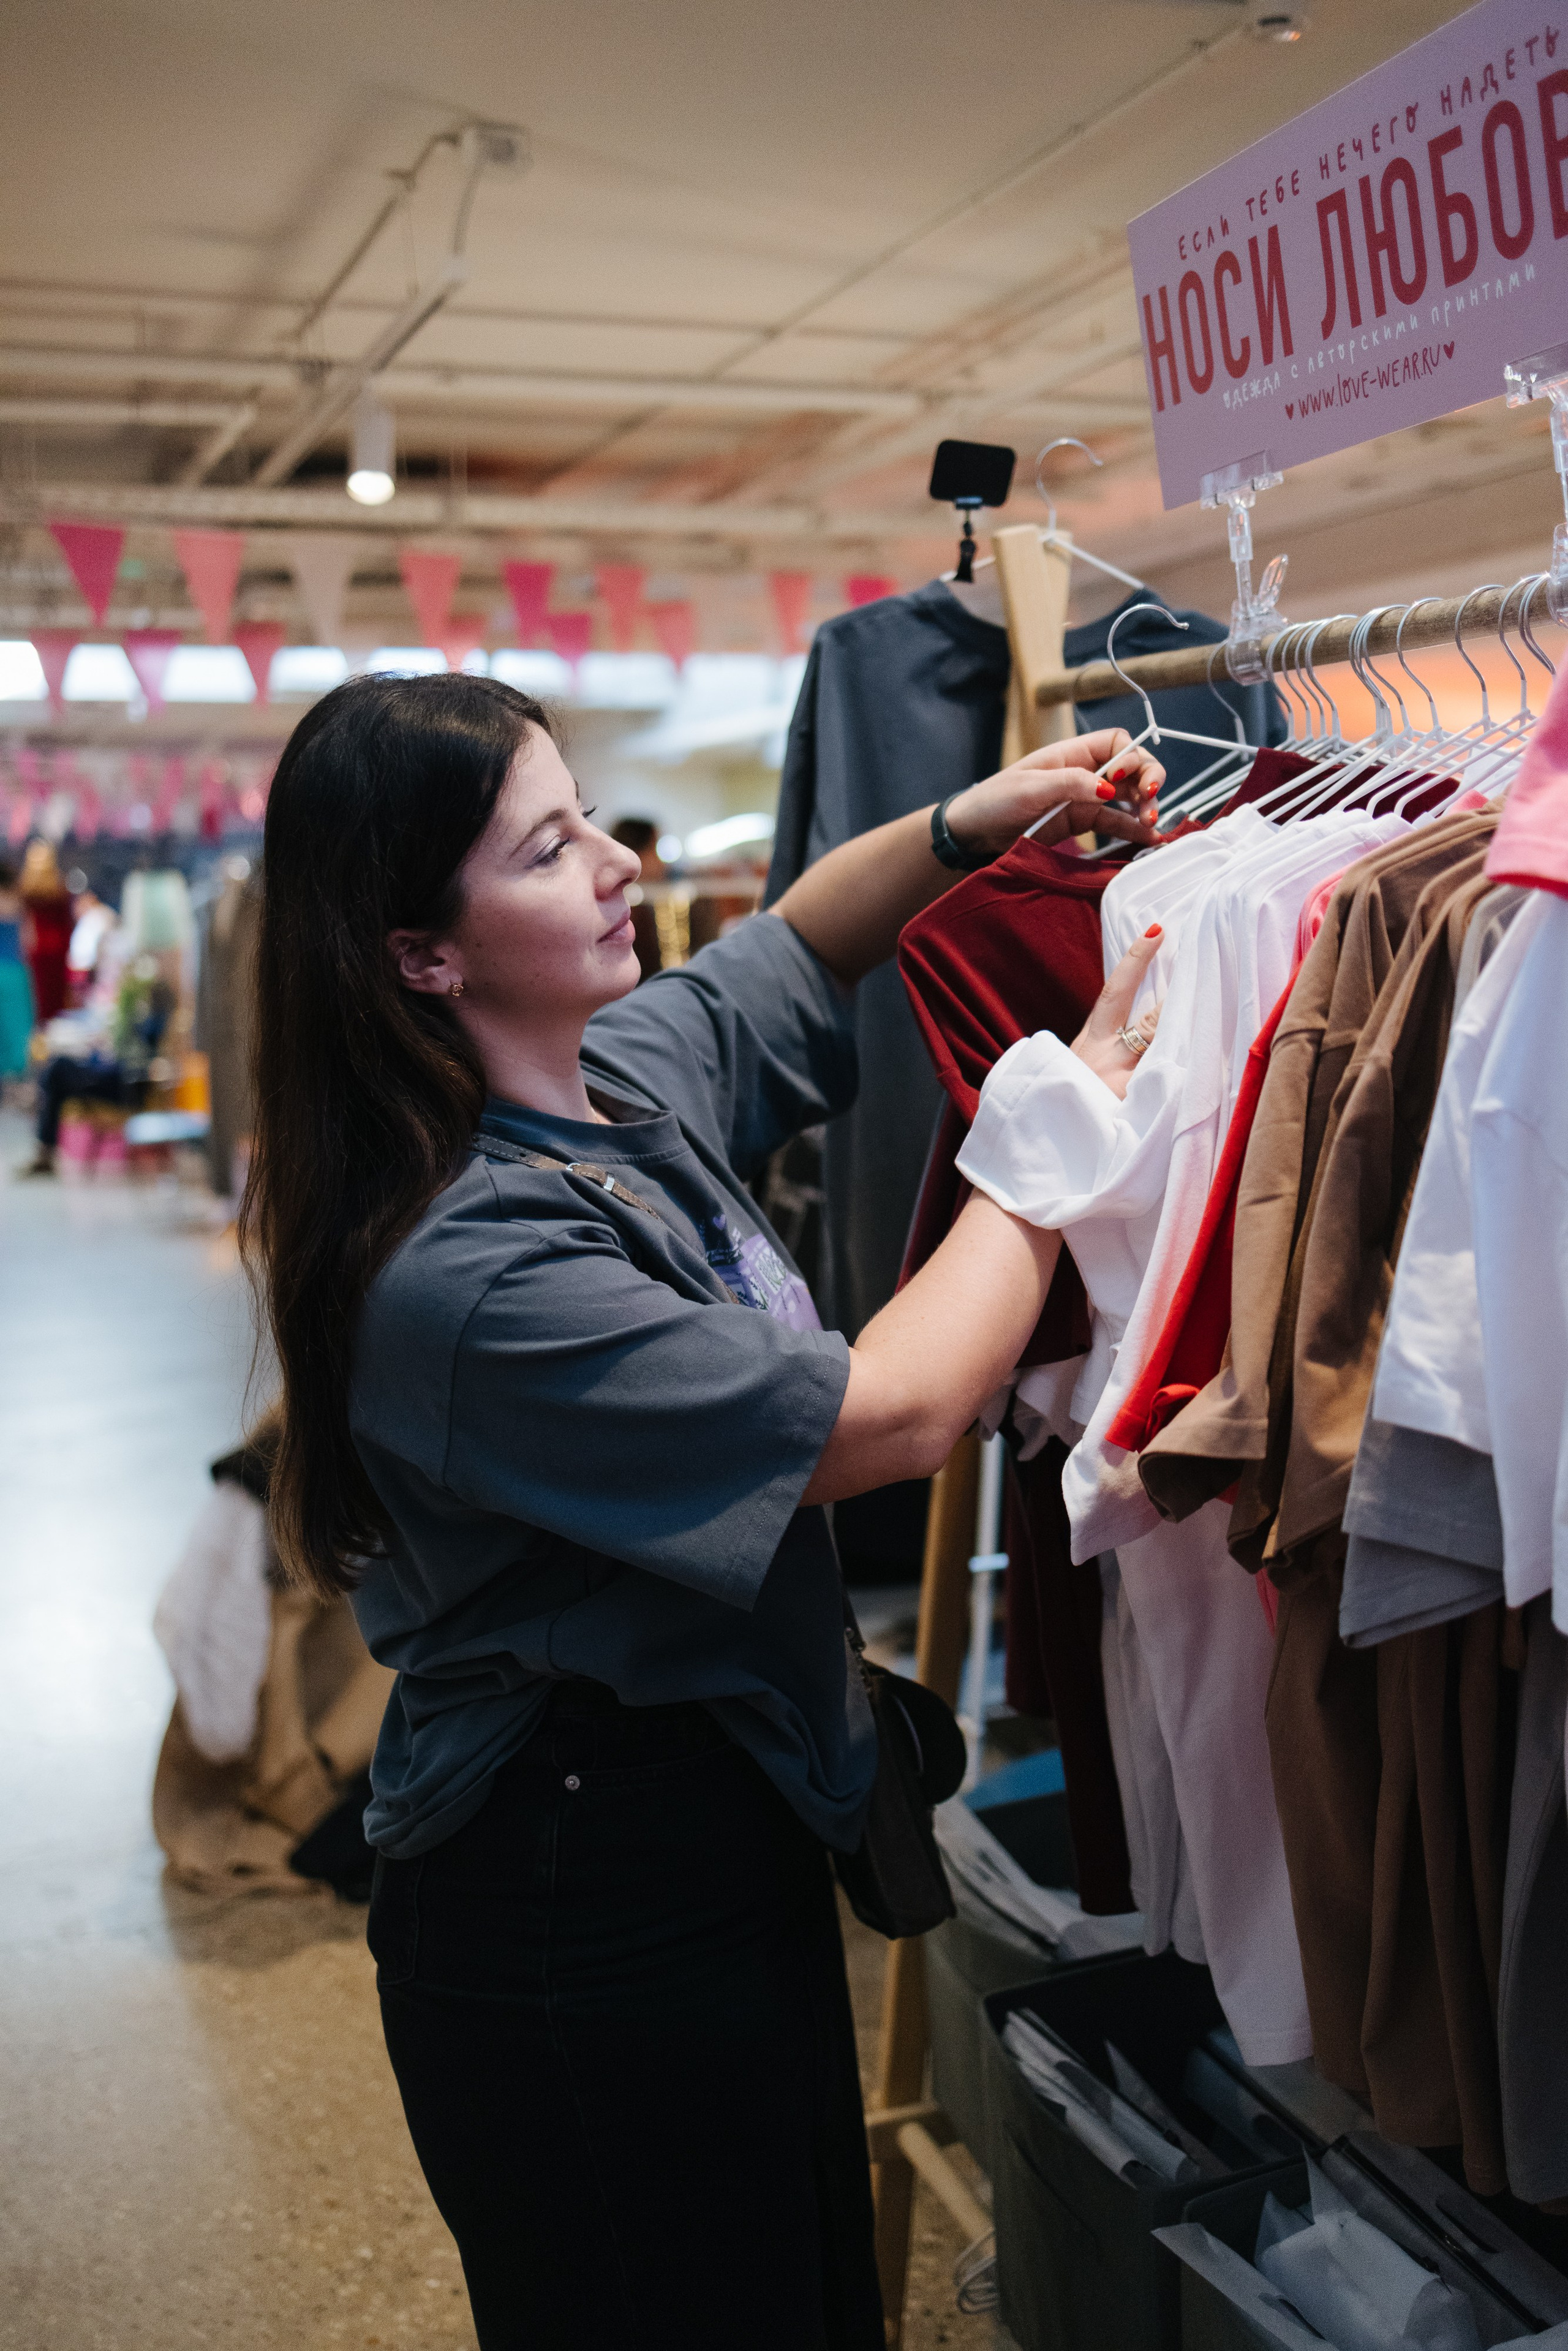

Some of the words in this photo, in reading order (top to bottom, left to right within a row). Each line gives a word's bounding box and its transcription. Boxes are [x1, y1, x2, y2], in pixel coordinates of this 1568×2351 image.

[1178, 215, 1229, 260] ЕСЛИ
[1245, 169, 1300, 221] ТЕБЕ
[1319, 102, 1419, 180] НЕЧЕГО
[1440, 25, 1559, 115] НАДЕТЬ
[1143, 224, 1294, 412] НОСИ
[1223, 371, 1281, 410] ОДЕЖДА
[1307, 314, 1418, 374] АВТОРСКИМИ
[1431, 263, 1534, 327] ПРИНТАМИ
